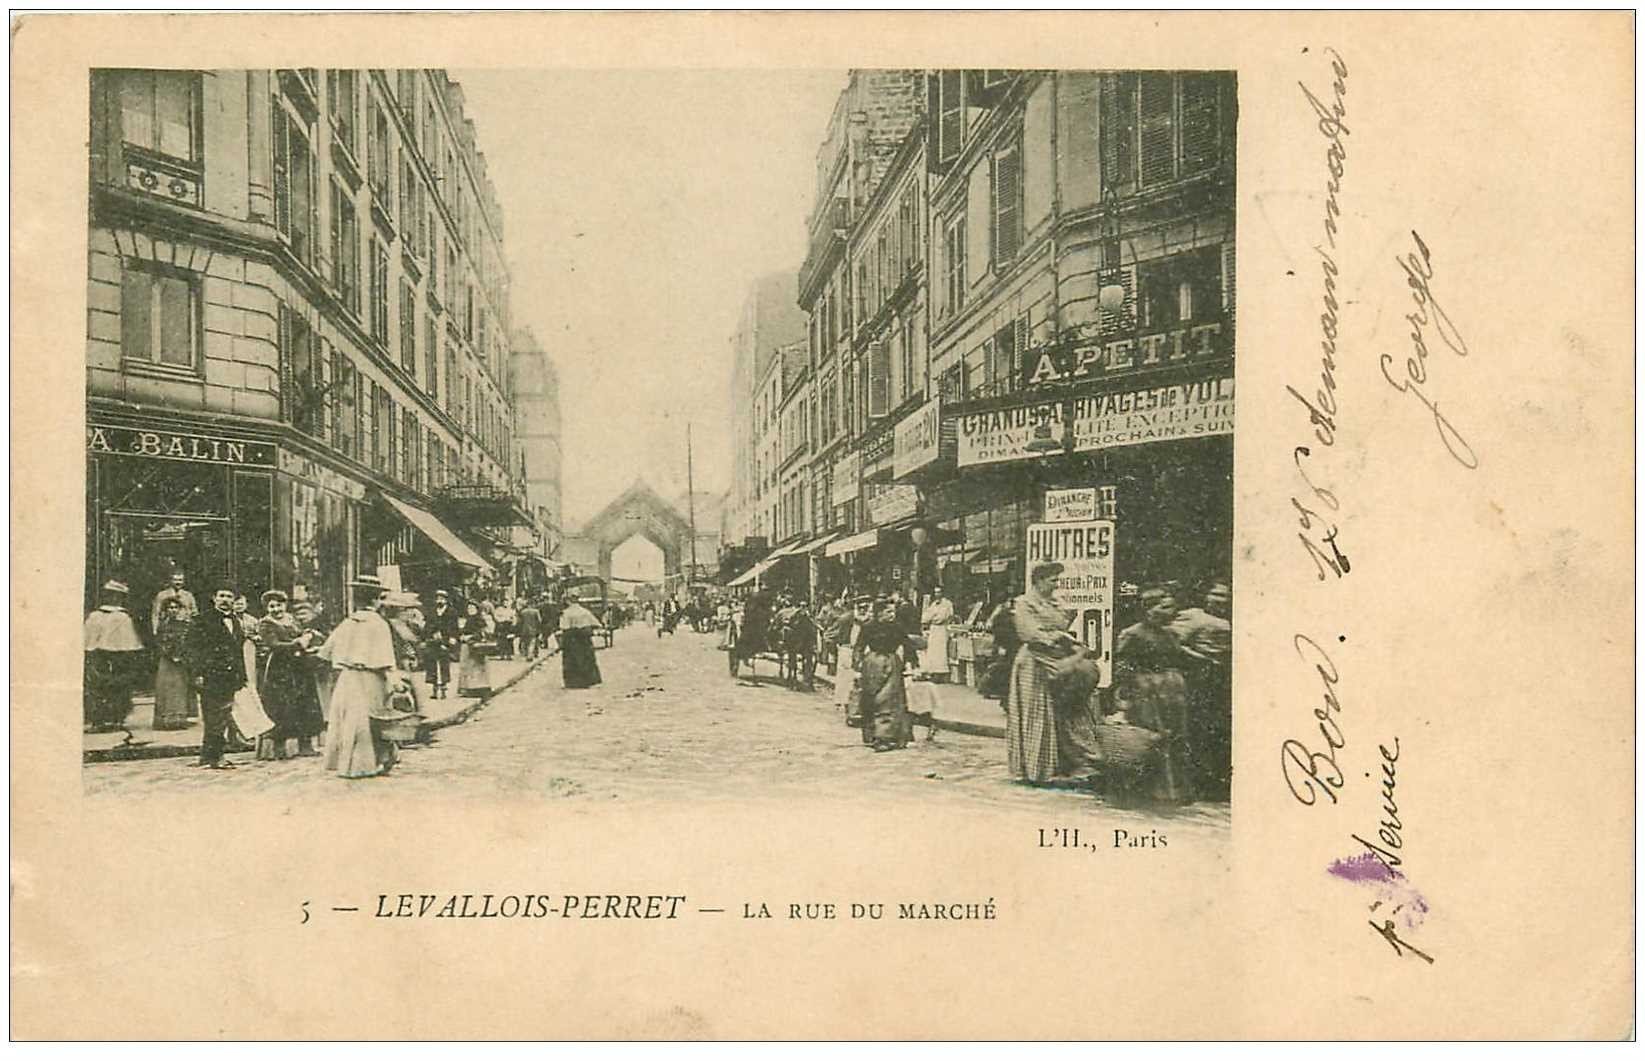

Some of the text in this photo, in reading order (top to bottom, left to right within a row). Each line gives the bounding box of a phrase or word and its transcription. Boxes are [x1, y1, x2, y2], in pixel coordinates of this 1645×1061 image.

[1072, 322, 1222, 376] PETIT
[962, 407, 1038, 437] GRANDS
[131, 431, 246, 464] BALIN
[1029, 526, 1111, 561] HUITRES
